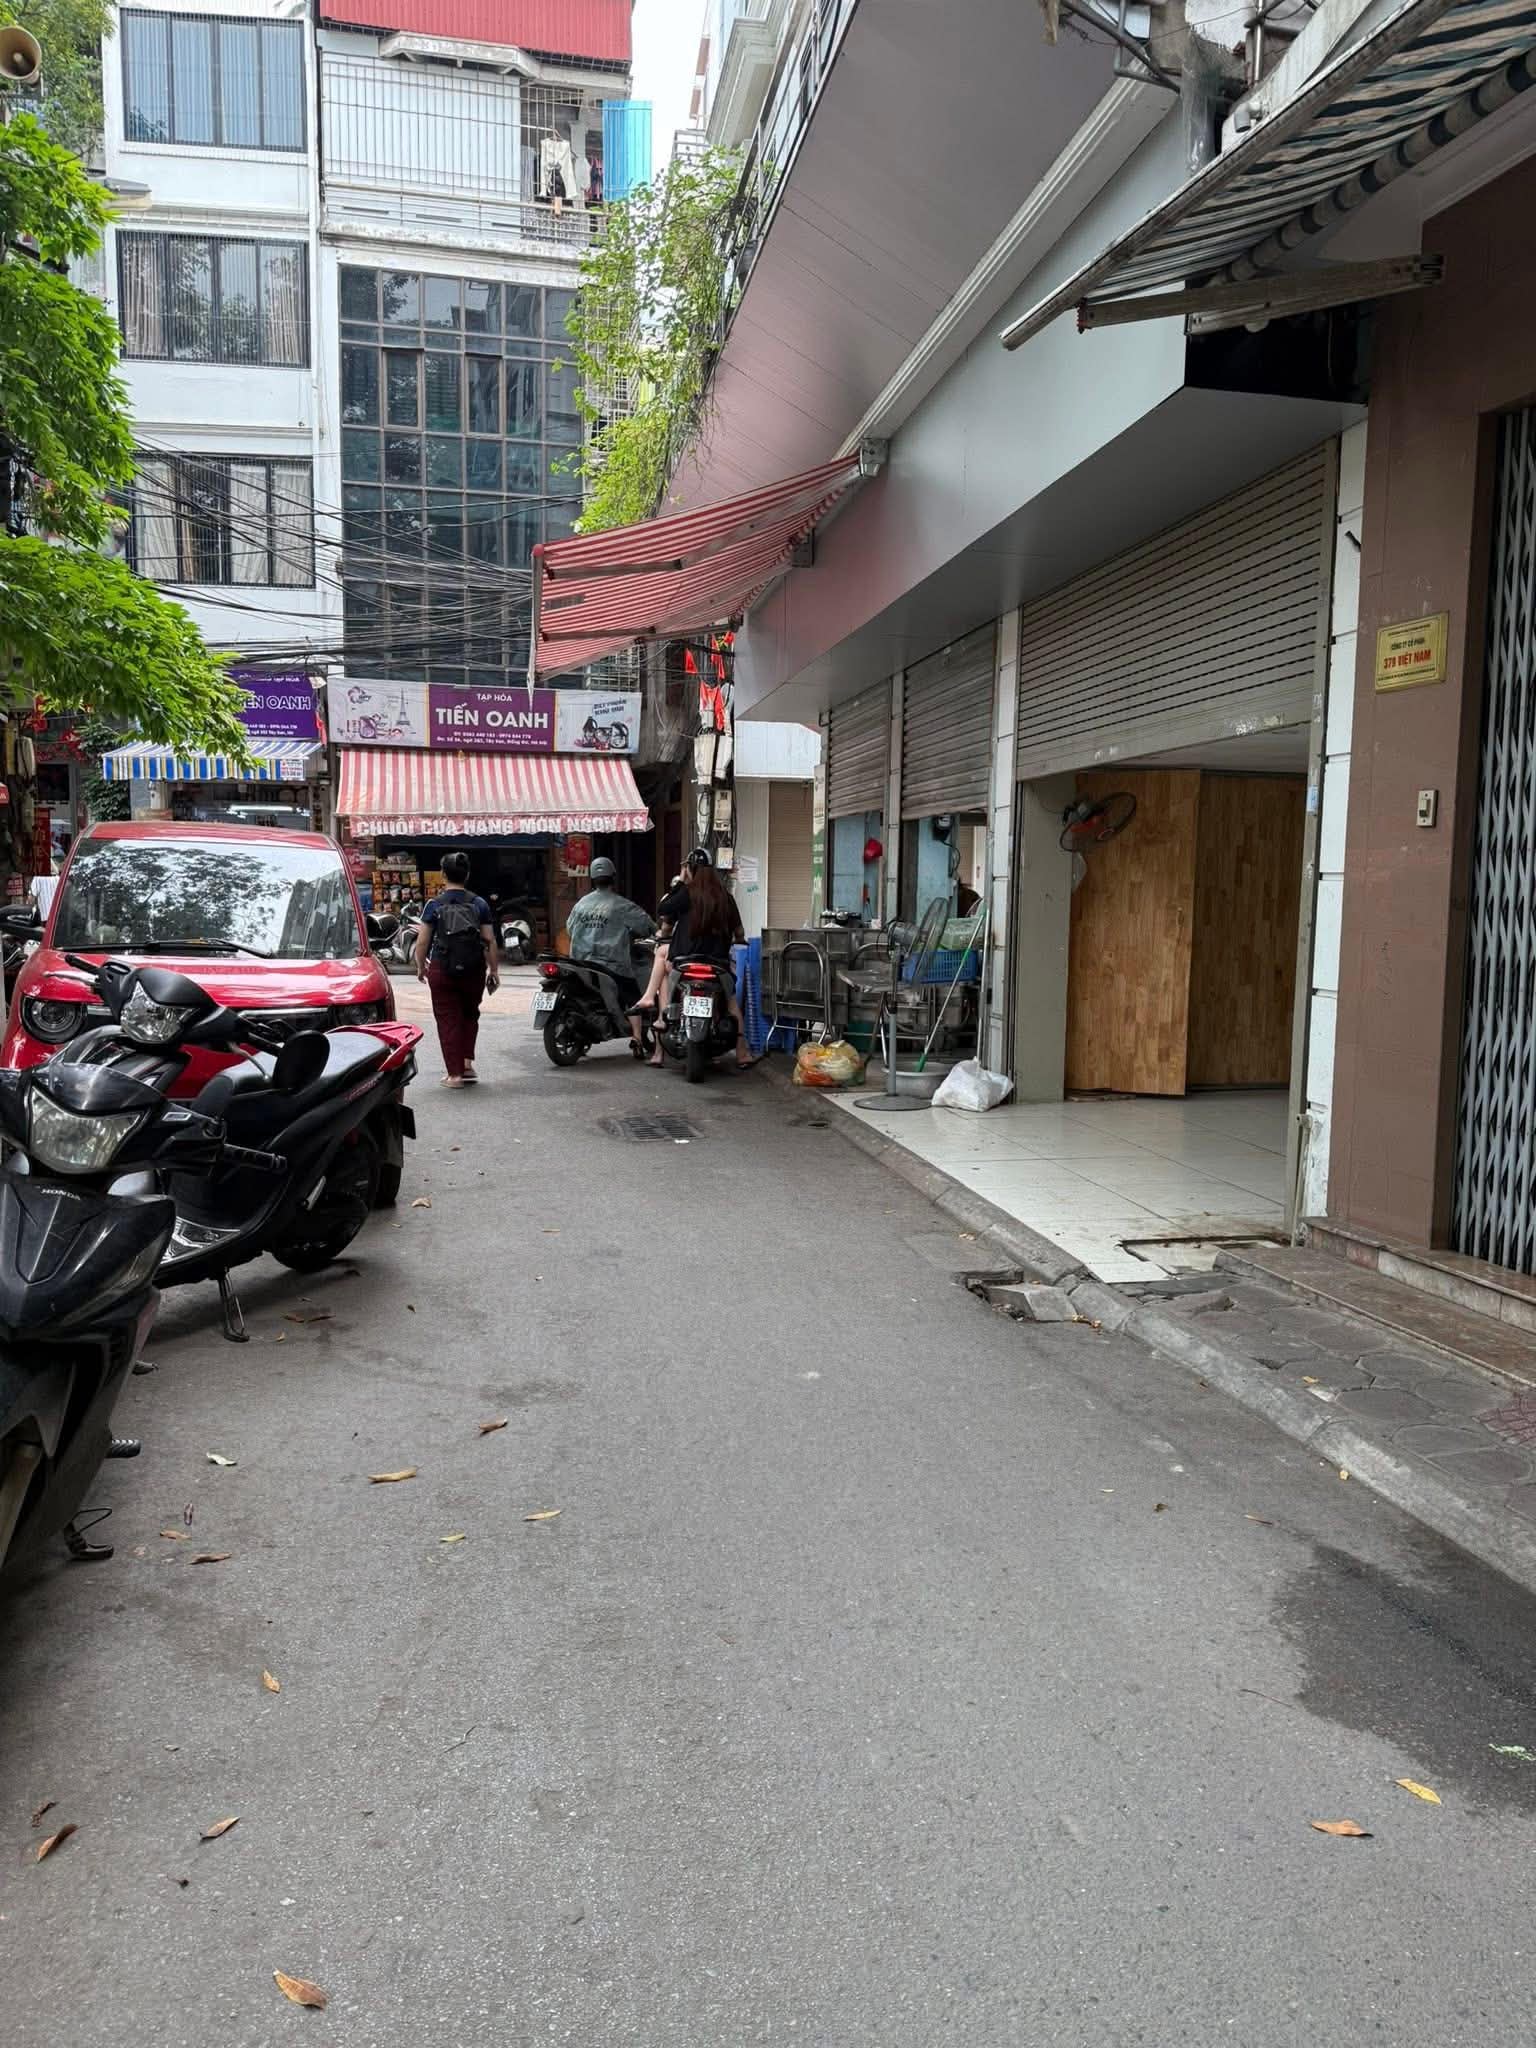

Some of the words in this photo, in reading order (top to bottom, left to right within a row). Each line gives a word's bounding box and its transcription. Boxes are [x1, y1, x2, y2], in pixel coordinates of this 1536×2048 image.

[1414, 649, 1431, 664] NAM
[266, 696, 311, 710] OANH
[476, 693, 492, 702] TẠP
[494, 692, 512, 702] HÓA
[436, 702, 479, 725] TIẾN
[486, 711, 548, 728] OANH
[41, 1188, 81, 1201] HONDA
